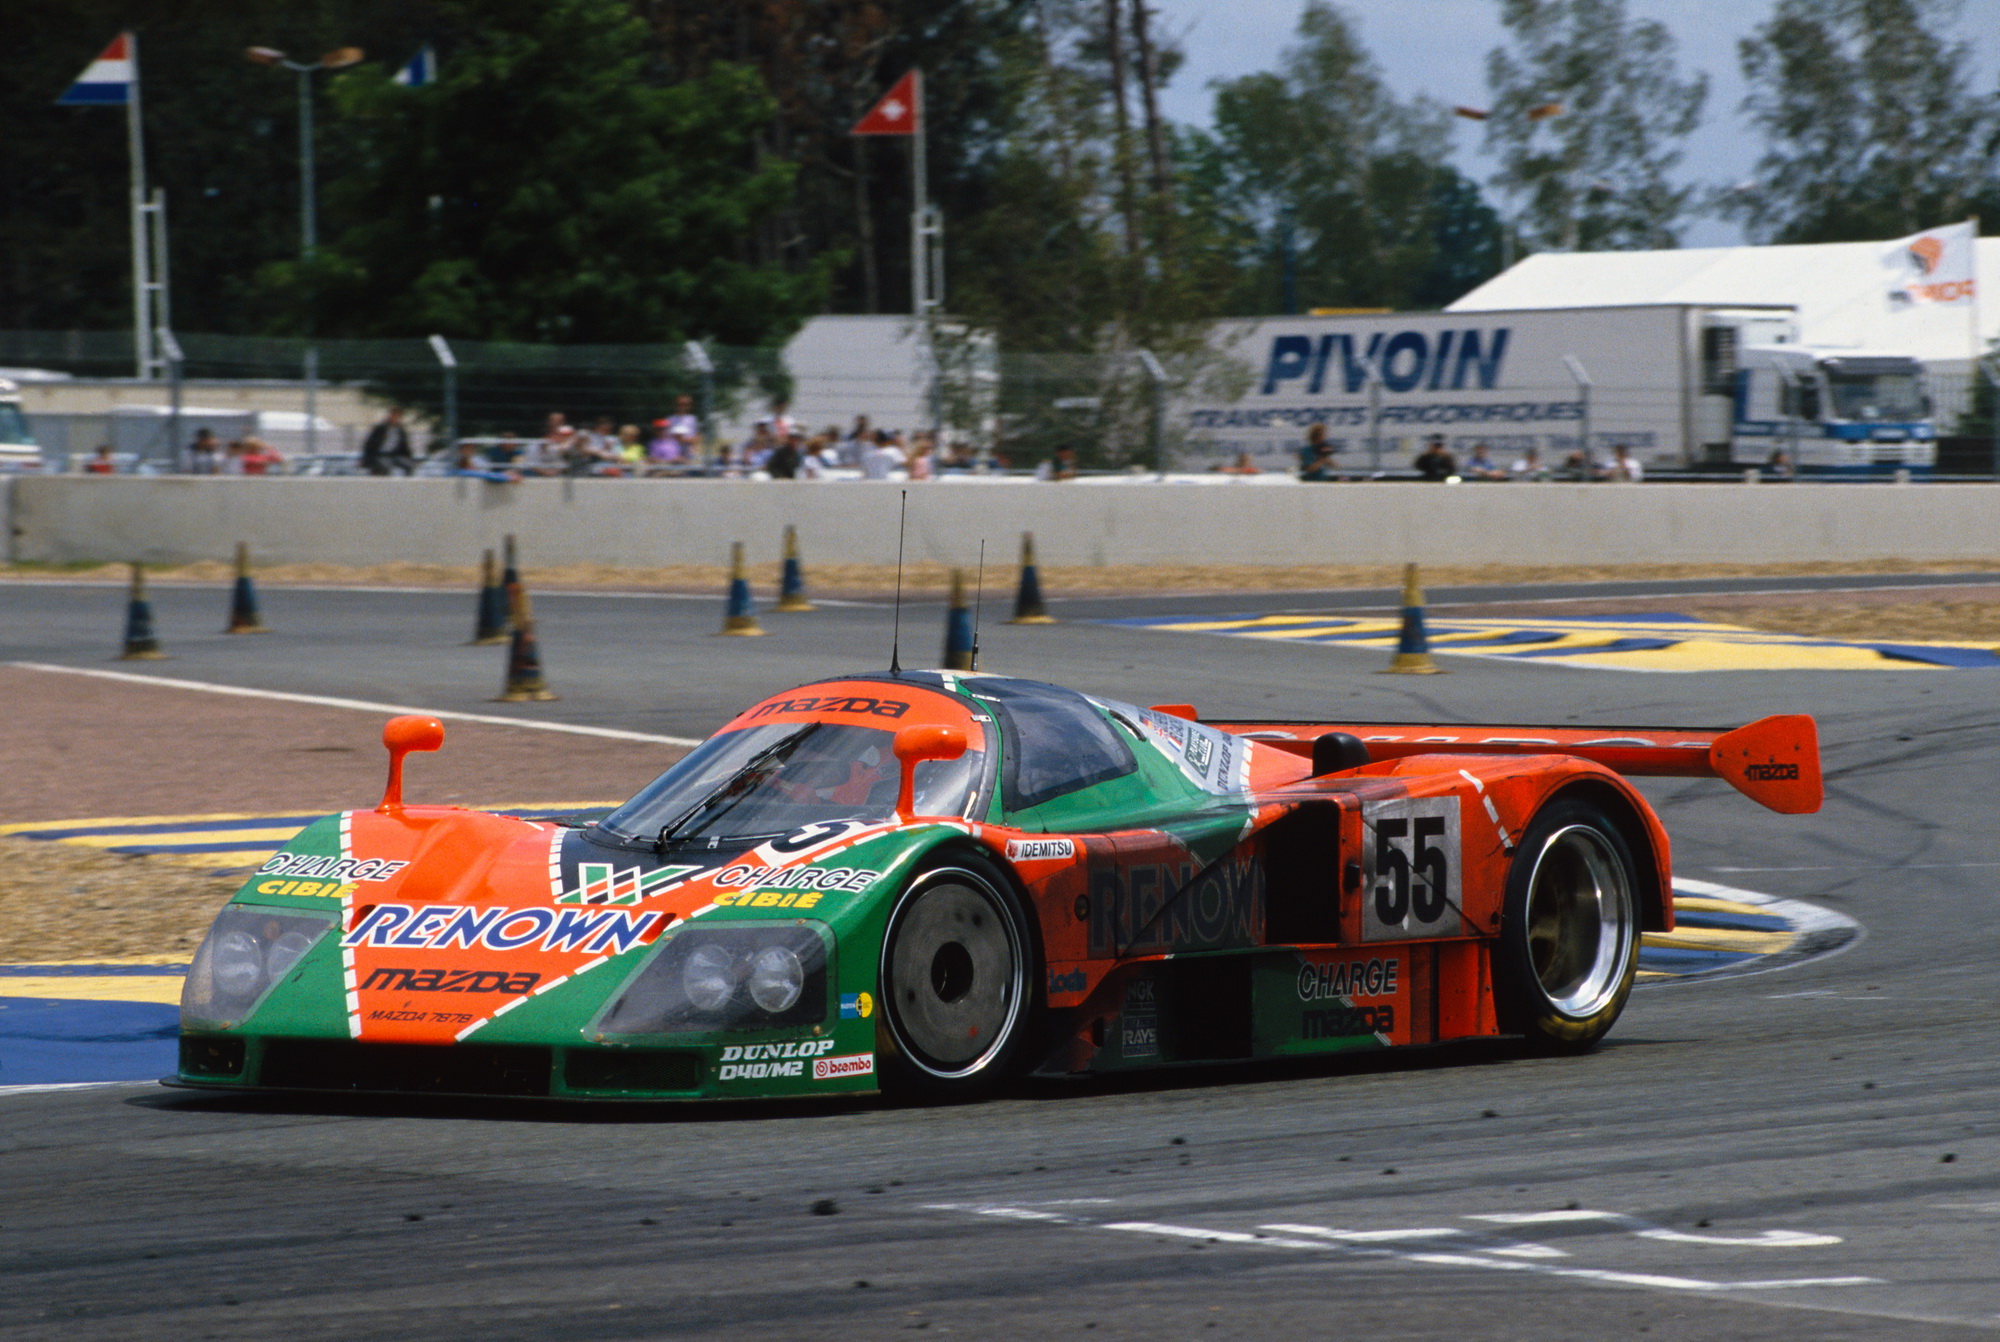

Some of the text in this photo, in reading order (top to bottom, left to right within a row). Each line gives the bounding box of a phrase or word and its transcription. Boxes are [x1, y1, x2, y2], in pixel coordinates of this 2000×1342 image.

[1261, 328, 1513, 395] PIVOIN
[749, 697, 911, 719] mazda
[1748, 763, 1799, 780] mazda
[1020, 841, 1072, 857] IDEMITSU
[255, 852, 411, 882] CHARGE
[712, 863, 882, 894] CHARGE
[1374, 816, 1447, 926] 55
[339, 903, 664, 955] RENOWN
[359, 967, 542, 995] mazda
[1126, 980, 1155, 1000] NGK
[1297, 957, 1400, 1002] CHARGE
[367, 1010, 428, 1021] MAZDA
[1302, 1004, 1395, 1039] mazda
[1122, 1027, 1157, 1046] RAYS
[719, 1039, 835, 1062] DUNLOP
[719, 1060, 804, 1081] D40/M2
[829, 1057, 872, 1074] brembo
